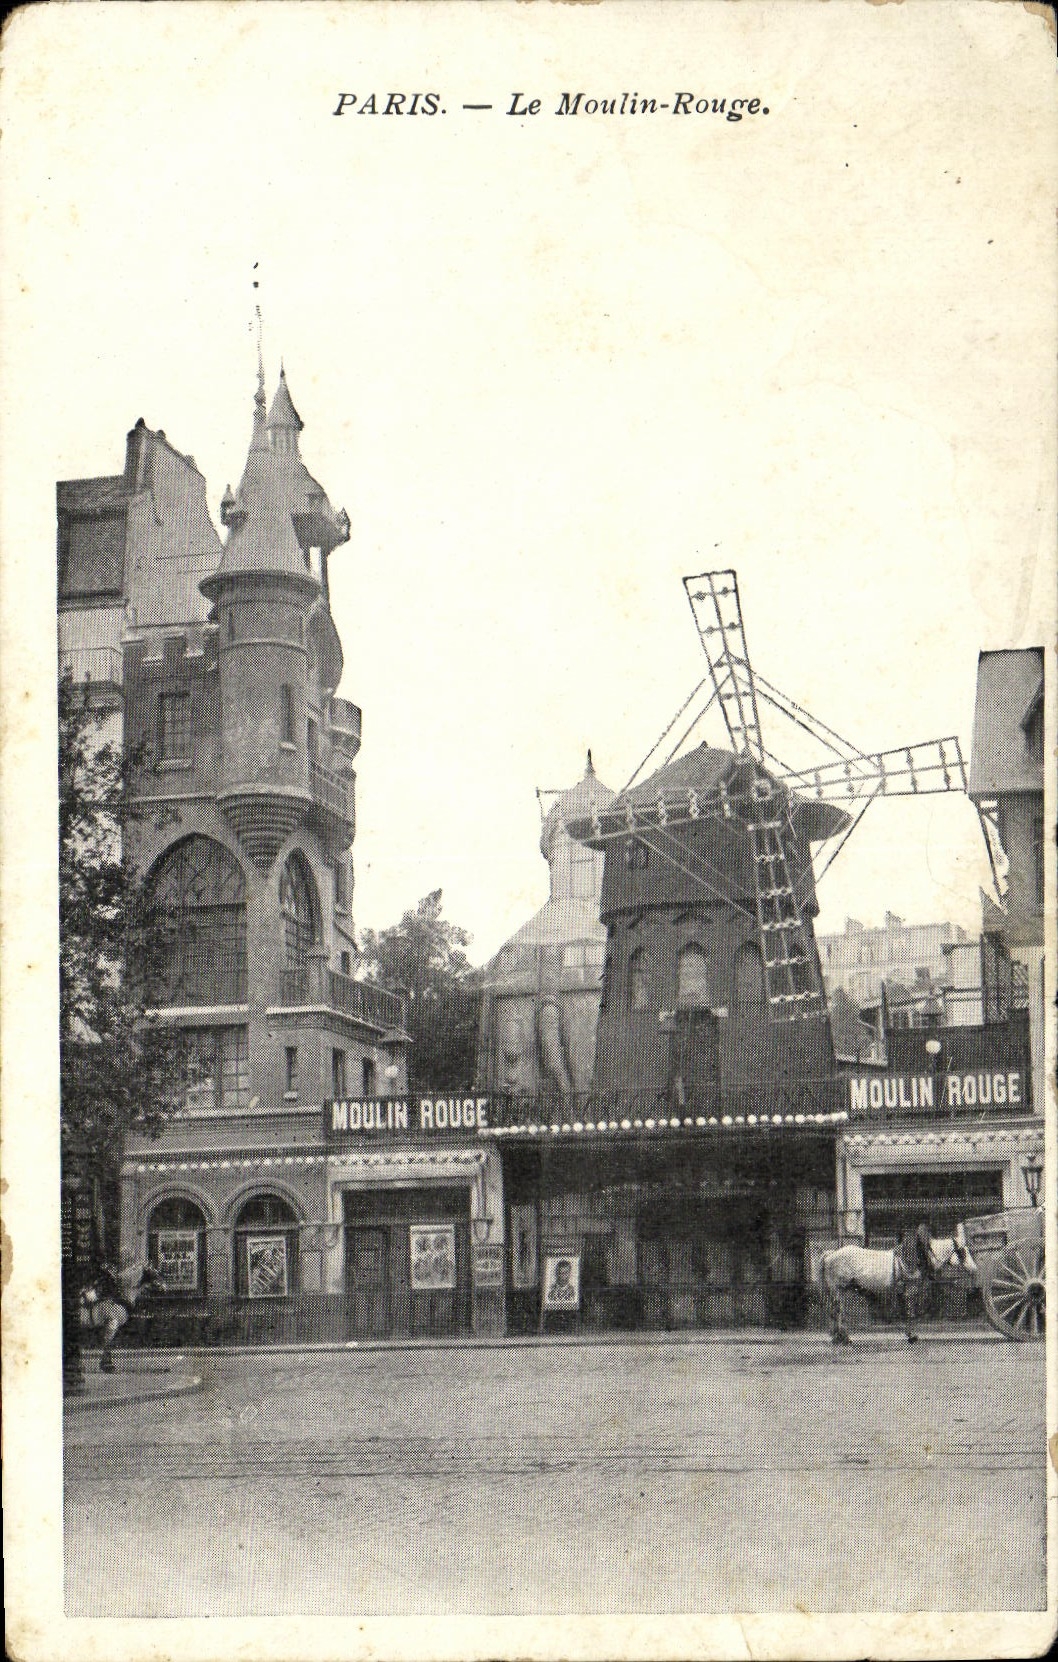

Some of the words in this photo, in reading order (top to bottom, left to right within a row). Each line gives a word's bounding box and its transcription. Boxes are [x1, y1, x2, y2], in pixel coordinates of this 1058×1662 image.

[850, 1077, 934, 1110] MOULIN
[947, 1072, 1022, 1106] ROUGE
[332, 1101, 408, 1131] MOULIN
[421, 1098, 489, 1129] ROUGE
